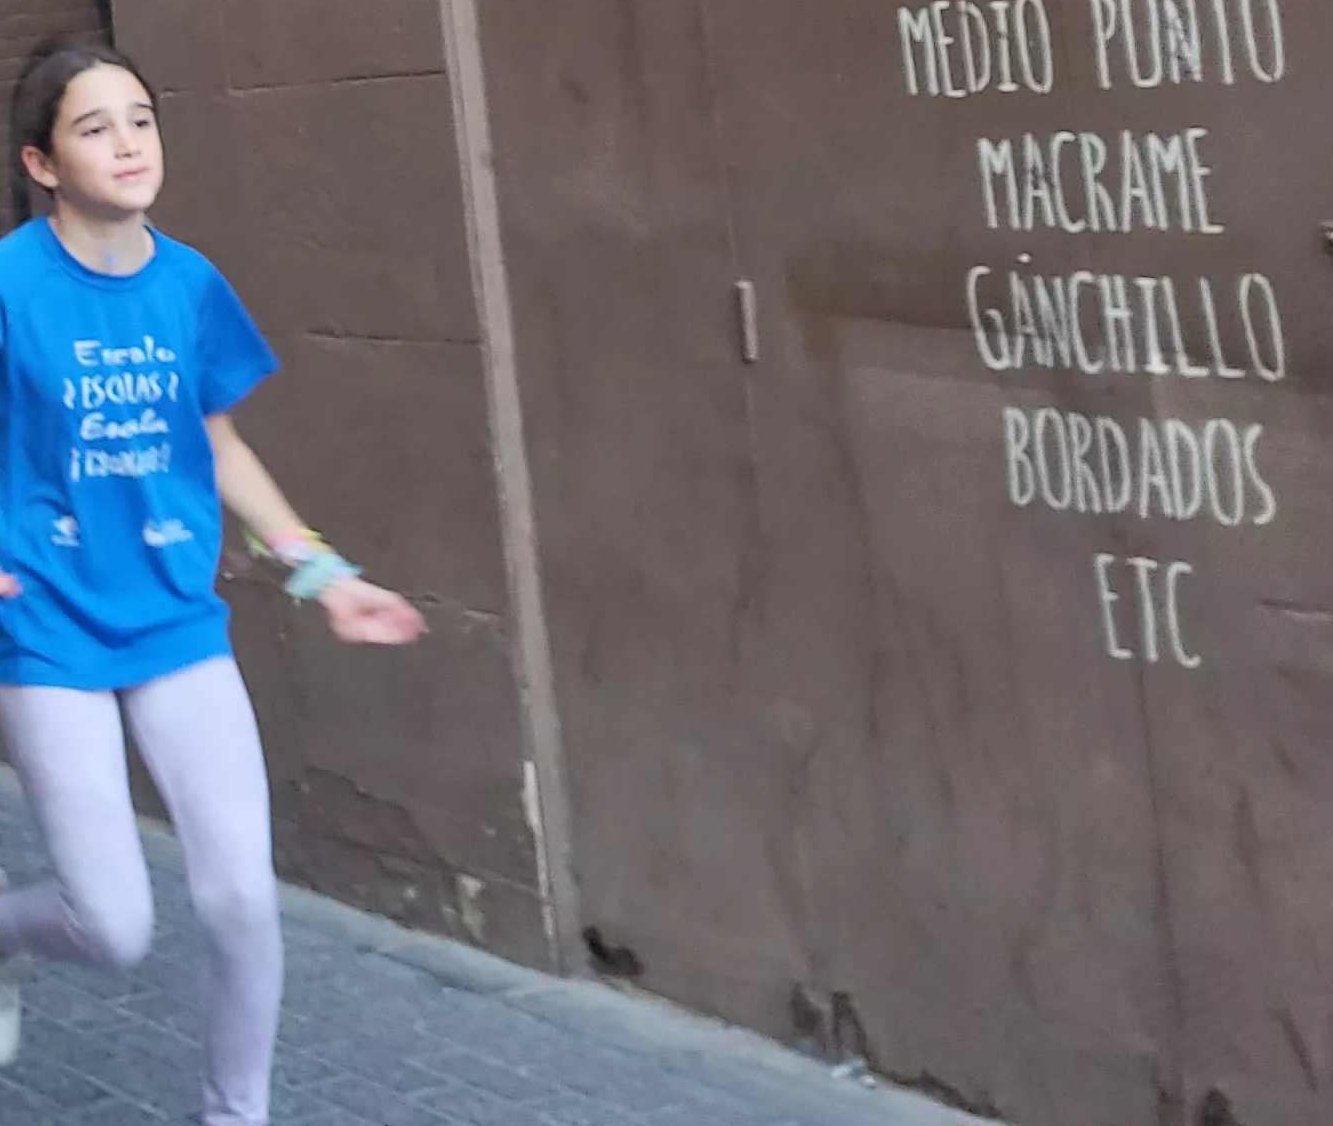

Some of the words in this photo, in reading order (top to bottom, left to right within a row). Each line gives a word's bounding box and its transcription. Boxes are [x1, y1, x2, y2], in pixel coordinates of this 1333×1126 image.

[975, 126, 1226, 235] MACRAME
[966, 263, 1287, 383] GANCHILLO
[1002, 405, 1277, 527] BORDADOS
[1093, 552, 1203, 669] ETC
